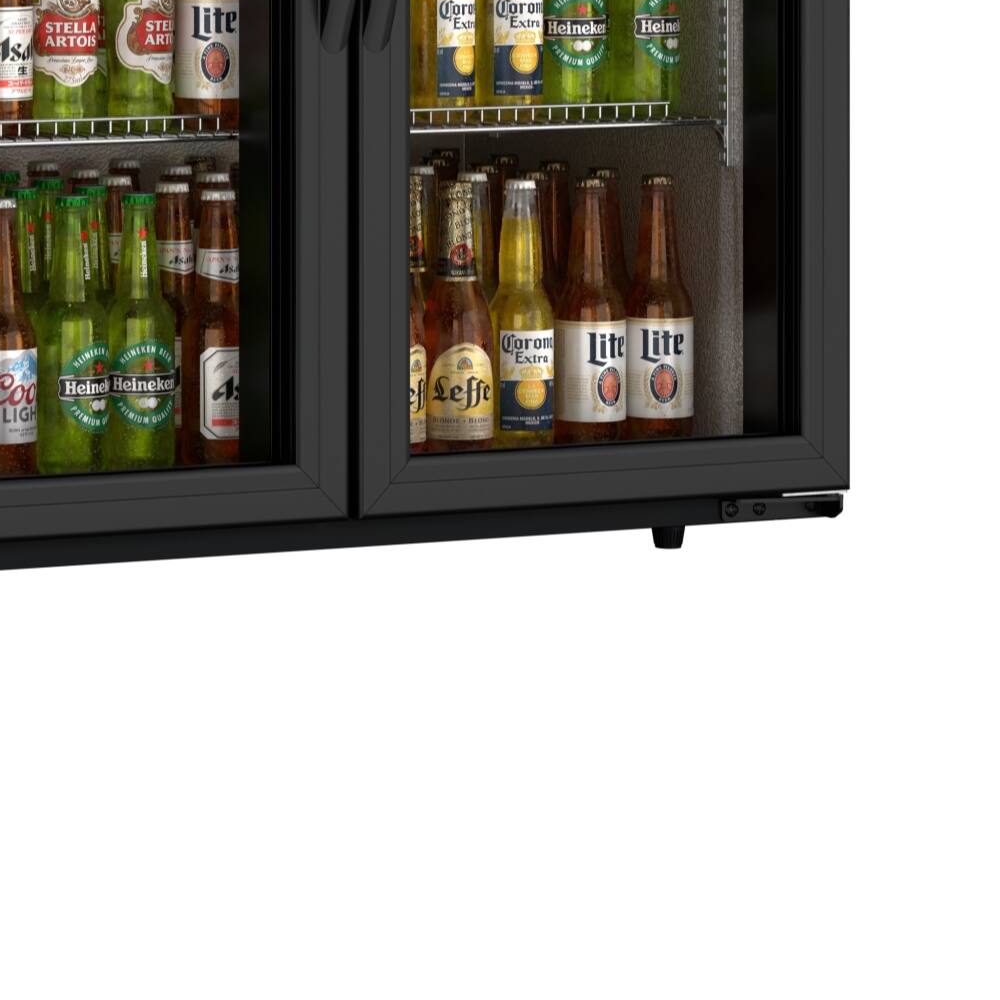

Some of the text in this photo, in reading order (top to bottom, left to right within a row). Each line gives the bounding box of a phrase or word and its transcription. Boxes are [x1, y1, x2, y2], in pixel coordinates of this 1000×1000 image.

[45, 21, 97, 34] STELLA
[192, 6, 237, 42] Lite
[510, 15, 540, 29] Extra
[45, 34, 97, 48] ARTOIS
[120, 345, 156, 364] HEINEKEN
[587, 332, 625, 367] Lite
[640, 328, 684, 363] Lite
[514, 350, 549, 364] Extra
[432, 375, 491, 411] Leffe
